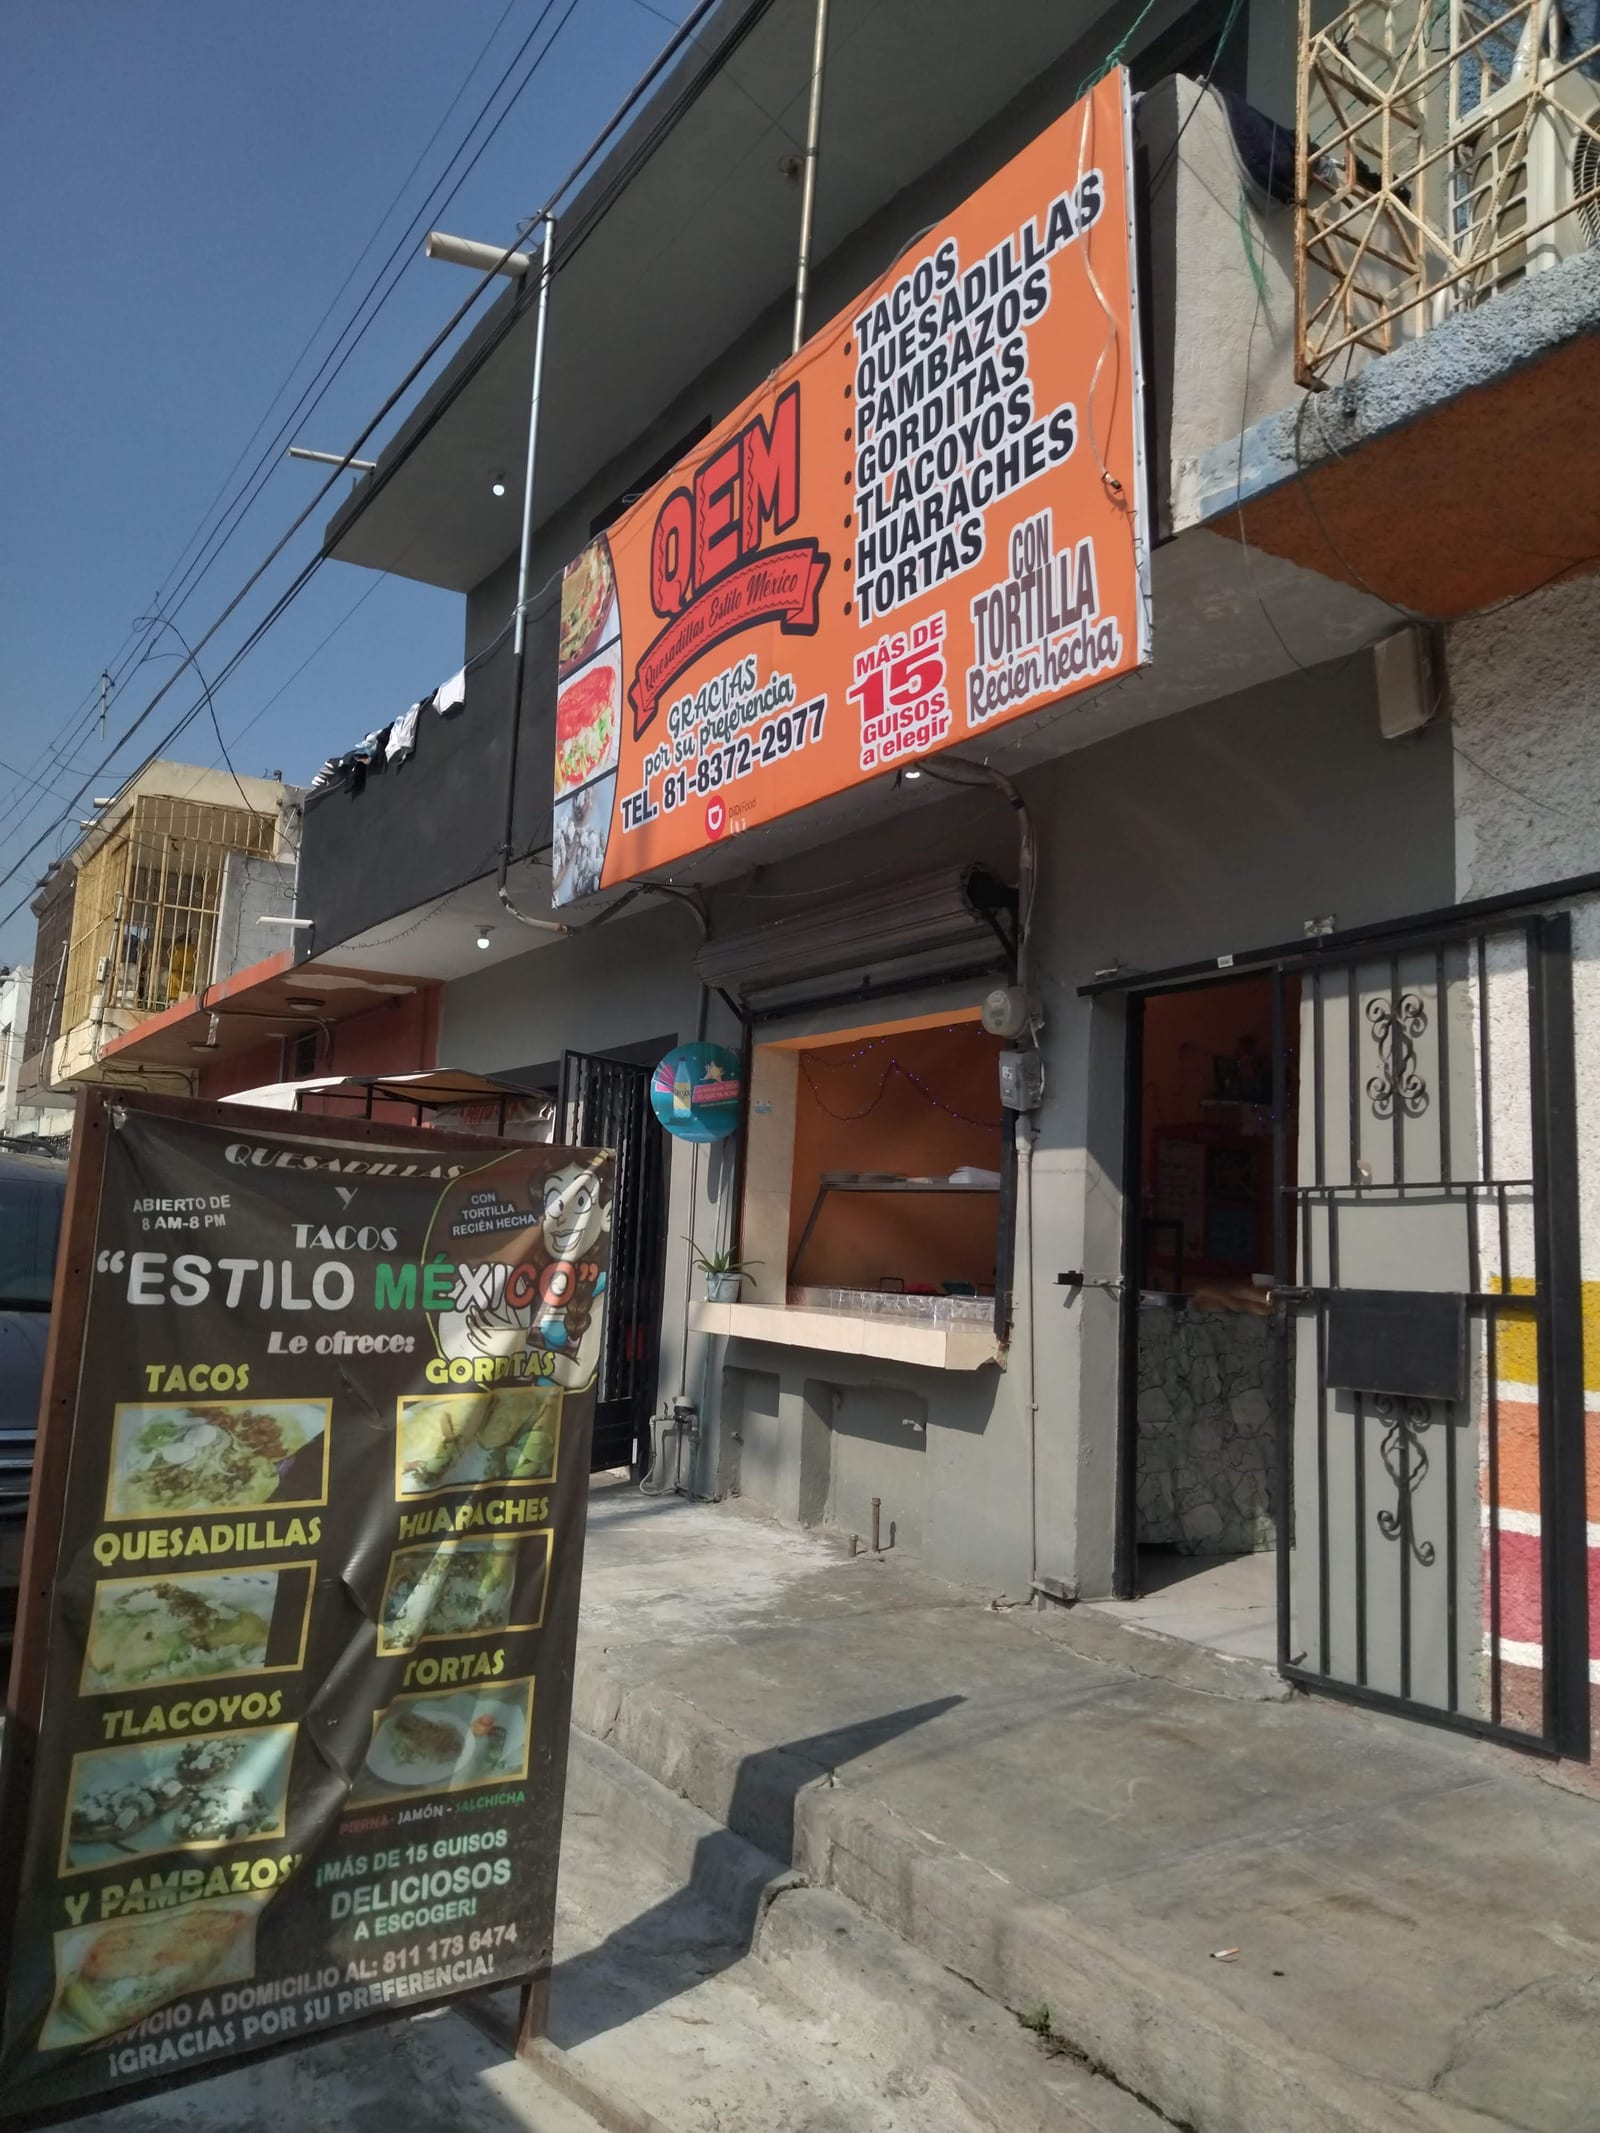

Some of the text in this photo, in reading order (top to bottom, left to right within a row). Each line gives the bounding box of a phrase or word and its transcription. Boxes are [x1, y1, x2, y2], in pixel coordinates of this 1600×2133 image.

[855, 241, 955, 355] TACOS
[856, 173, 1101, 399] QUESADILLAS
[857, 268, 1047, 446] PAMBAZOS
[857, 336, 1024, 488] GORDITAS
[856, 383, 1031, 532] TLACOYOS
[857, 408, 1074, 579] HUARACHES
[856, 516, 982, 622] TORTAS
[1012, 513, 1050, 580] CON
[645, 569, 799, 691] Quesadillas Estilo México
[973, 543, 1096, 667] TORTILLA
[856, 615, 944, 677] MÁS DE
[969, 618, 1119, 722] Recien hecha
[668, 657, 756, 739] GRACIAS
[848, 642, 944, 722] 15
[643, 675, 794, 786] por su preferencia
[862, 691, 946, 745] GUISOS
[862, 714, 949, 766] a elegir
[621, 699, 826, 830] TEL. 81-8372-2977
[224, 1143, 465, 1180] QUESADILLAS
[133, 1194, 232, 1214] ABIERTO DE
[142, 1213, 227, 1232] 8 AM-8 PM
[334, 1186, 359, 1211] Y
[452, 1213, 537, 1237] RECIÉN HECHA
[461, 1203, 516, 1221] TORTILLA
[471, 1192, 497, 1206] CON
[291, 1223, 398, 1252] TACOS
[267, 1330, 416, 1356] Le ofrece:
[424, 1350, 556, 1385] GORDITAS
[145, 1362, 250, 1393] TACOS
[93, 1516, 322, 1568] QUESADILLAS
[398, 1496, 549, 1541] HUARACHES
[402, 1648, 506, 1688] TORTAS
[102, 1689, 283, 1740] TLACOYOS
[372, 1849, 401, 1874] DE
[404, 1844, 429, 1866] 15
[432, 1828, 509, 1860] GUISOS
[64, 1890, 91, 1926] Y
[329, 1857, 513, 1921] DELICIOSOS
[353, 1896, 477, 1943] A ESCOGER!
[196, 1997, 217, 2023] A
[221, 1966, 340, 2016] DOMICILIO
[344, 1959, 379, 1982] AL:
[382, 1945, 420, 1974] 811
[427, 1934, 464, 1963] 173
[468, 1922, 519, 1951] 6474
[241, 2005, 297, 2041] POR
[303, 1991, 332, 2025] SU
[337, 1952, 495, 2016] PREFERENCIA!
